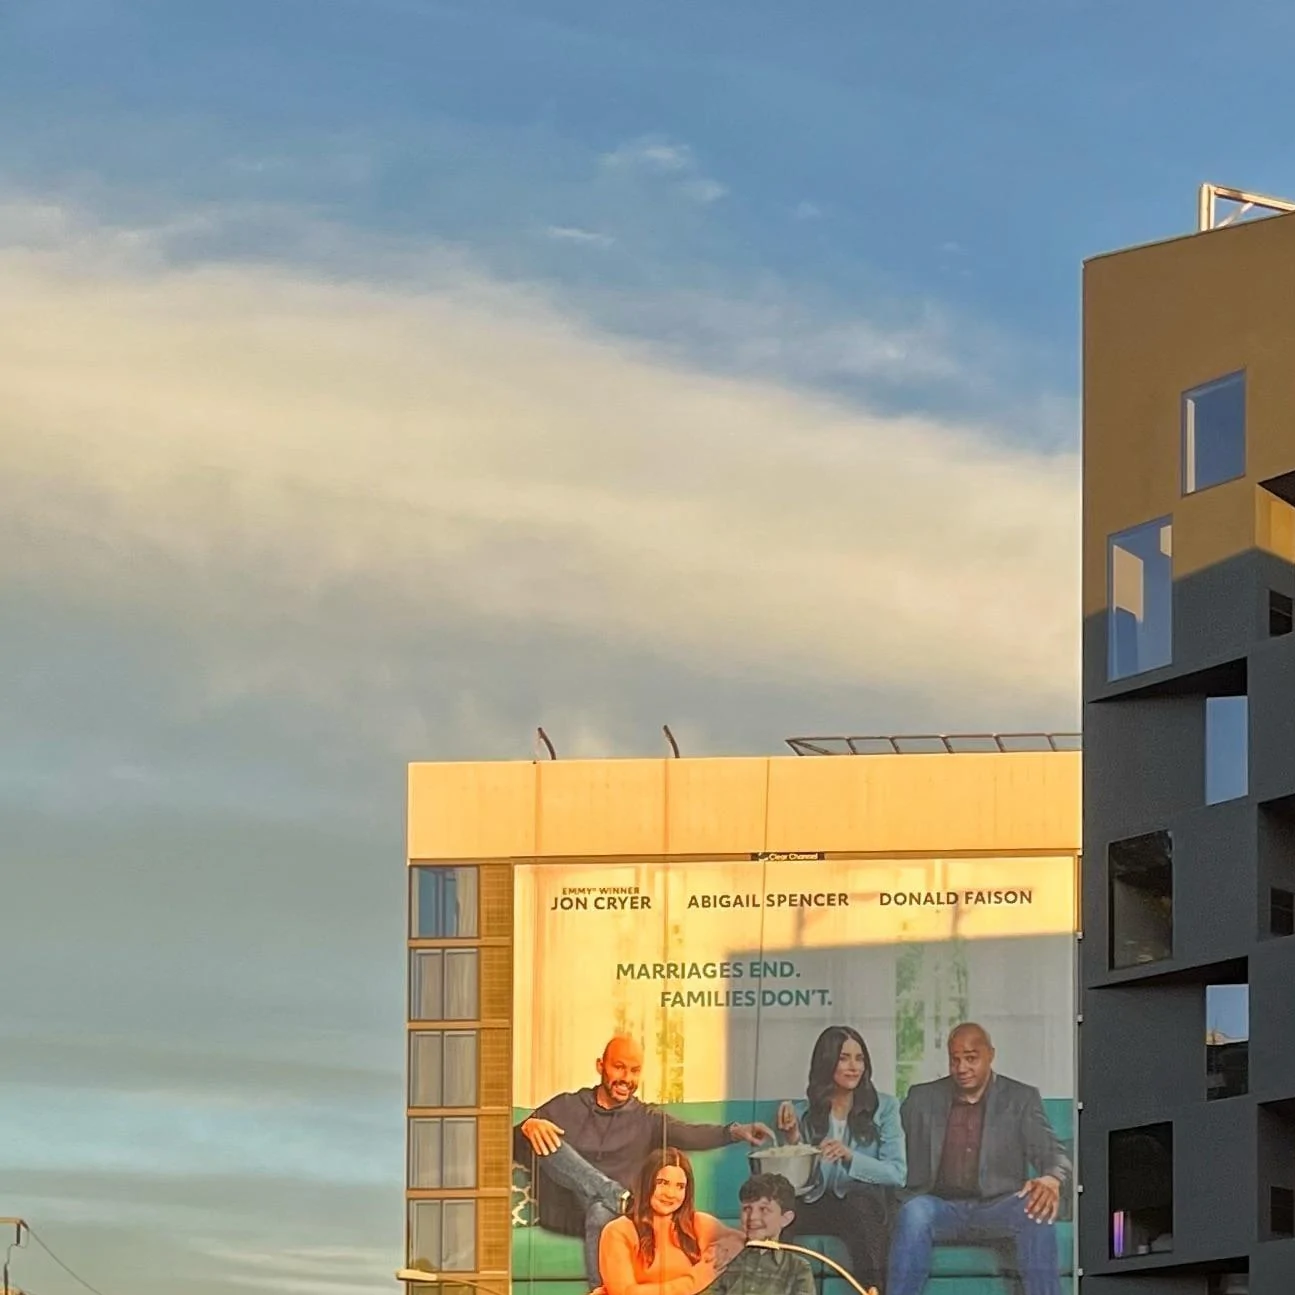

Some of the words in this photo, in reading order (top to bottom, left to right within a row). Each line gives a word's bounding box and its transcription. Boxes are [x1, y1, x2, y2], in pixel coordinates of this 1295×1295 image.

[550, 896, 588, 910] JON
[593, 895, 652, 910] CRYER
[687, 894, 761, 909] ABIGAIL
[766, 892, 850, 908] SPENCER
[879, 891, 959, 906] DONALD
[964, 890, 1033, 905] FAISON
[599, 886, 641, 895] WINNER
[616, 962, 744, 981] MARRIAGES
[749, 961, 801, 979] END.
[660, 990, 757, 1008] FAMILIES
